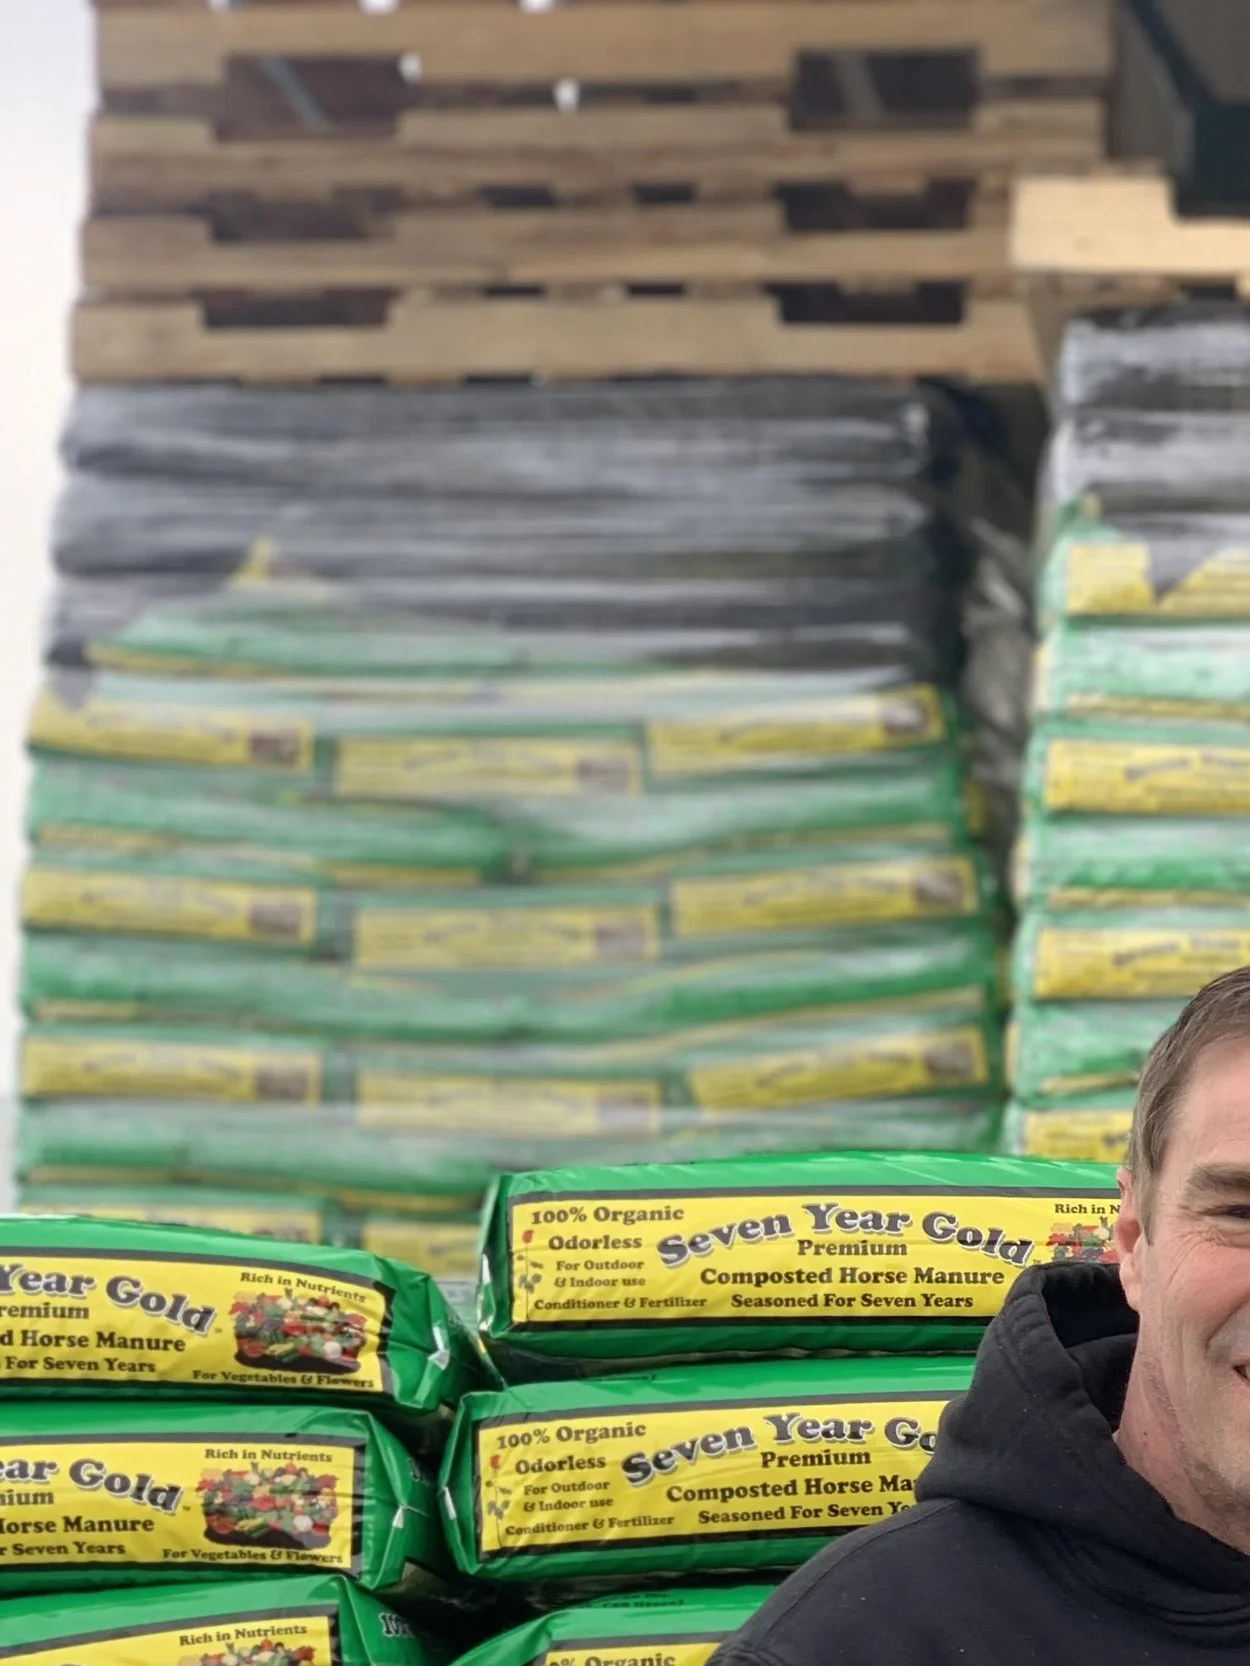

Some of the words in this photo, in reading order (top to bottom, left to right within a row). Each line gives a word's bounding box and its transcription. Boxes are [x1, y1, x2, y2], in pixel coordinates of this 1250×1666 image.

[531, 1207, 588, 1224] 100%
[593, 1206, 684, 1226] Organic
[1054, 1203, 1089, 1214] Rich
[1092, 1204, 1106, 1214] in
[548, 1235, 642, 1250] Odorless
[656, 1213, 796, 1270] Seven
[802, 1203, 913, 1235] Year
[922, 1212, 1036, 1268] Gold
[797, 1240, 908, 1257] Premium
[556, 1260, 580, 1270] For
[584, 1260, 644, 1270] Outdoor
[570, 1277, 619, 1287] Indoor
[622, 1277, 646, 1286] use
[700, 1267, 833, 1288] Composted
[839, 1267, 908, 1284] Horse
[914, 1268, 1005, 1285] Manure
[240, 1272, 274, 1284] Rich
[277, 1276, 292, 1286] in
[297, 1278, 366, 1303] Nutrients
[0, 1263, 97, 1299] Year
[105, 1275, 217, 1336] Gold
[534, 1299, 620, 1310] Conditioner
[640, 1297, 708, 1308] Fertilizer
[731, 1294, 819, 1308] Seasoned
[824, 1294, 856, 1307] For
[861, 1294, 916, 1307] Seven
[921, 1294, 973, 1307] Years
[20, 1329, 89, 1347] Horse
[96, 1332, 186, 1351] Manure
[6, 1356, 38, 1370] For
[43, 1357, 99, 1370] Seven
[104, 1358, 156, 1372] Years
[193, 1370, 217, 1380] For
[221, 1371, 297, 1385] Vegetables
[317, 1375, 374, 1388] Flowers
[497, 1428, 550, 1449] 100%
[556, 1422, 647, 1443] Organic
[205, 1449, 239, 1459] Rich
[242, 1450, 257, 1459] in
[261, 1450, 332, 1463] Nutrients
[621, 1425, 758, 1487] Seven
[764, 1412, 875, 1444] Year
[760, 1449, 871, 1469] Premium
[515, 1454, 606, 1475] Odorless
[69, 1458, 183, 1516] Gold
[524, 1484, 548, 1496] For
[551, 1481, 610, 1493] Outdoor
[666, 1479, 798, 1503] Composted
[804, 1477, 873, 1495] Horse
[539, 1500, 587, 1511] Indoor
[590, 1497, 614, 1508] use
[698, 1506, 786, 1524] Seasoned
[791, 1505, 822, 1519] For
[828, 1503, 883, 1518] Seven
[62, 1516, 154, 1533] Manure
[505, 1520, 589, 1536] Conditioner
[608, 1515, 674, 1528] Fertilizer
[12, 1543, 68, 1556] Seven
[73, 1541, 125, 1554] Years
[163, 1549, 187, 1559] For
[191, 1549, 266, 1561] Vegetables
[286, 1550, 343, 1563] Flowers
[179, 1633, 212, 1646] Rich
[235, 1625, 307, 1639] Nutrients
